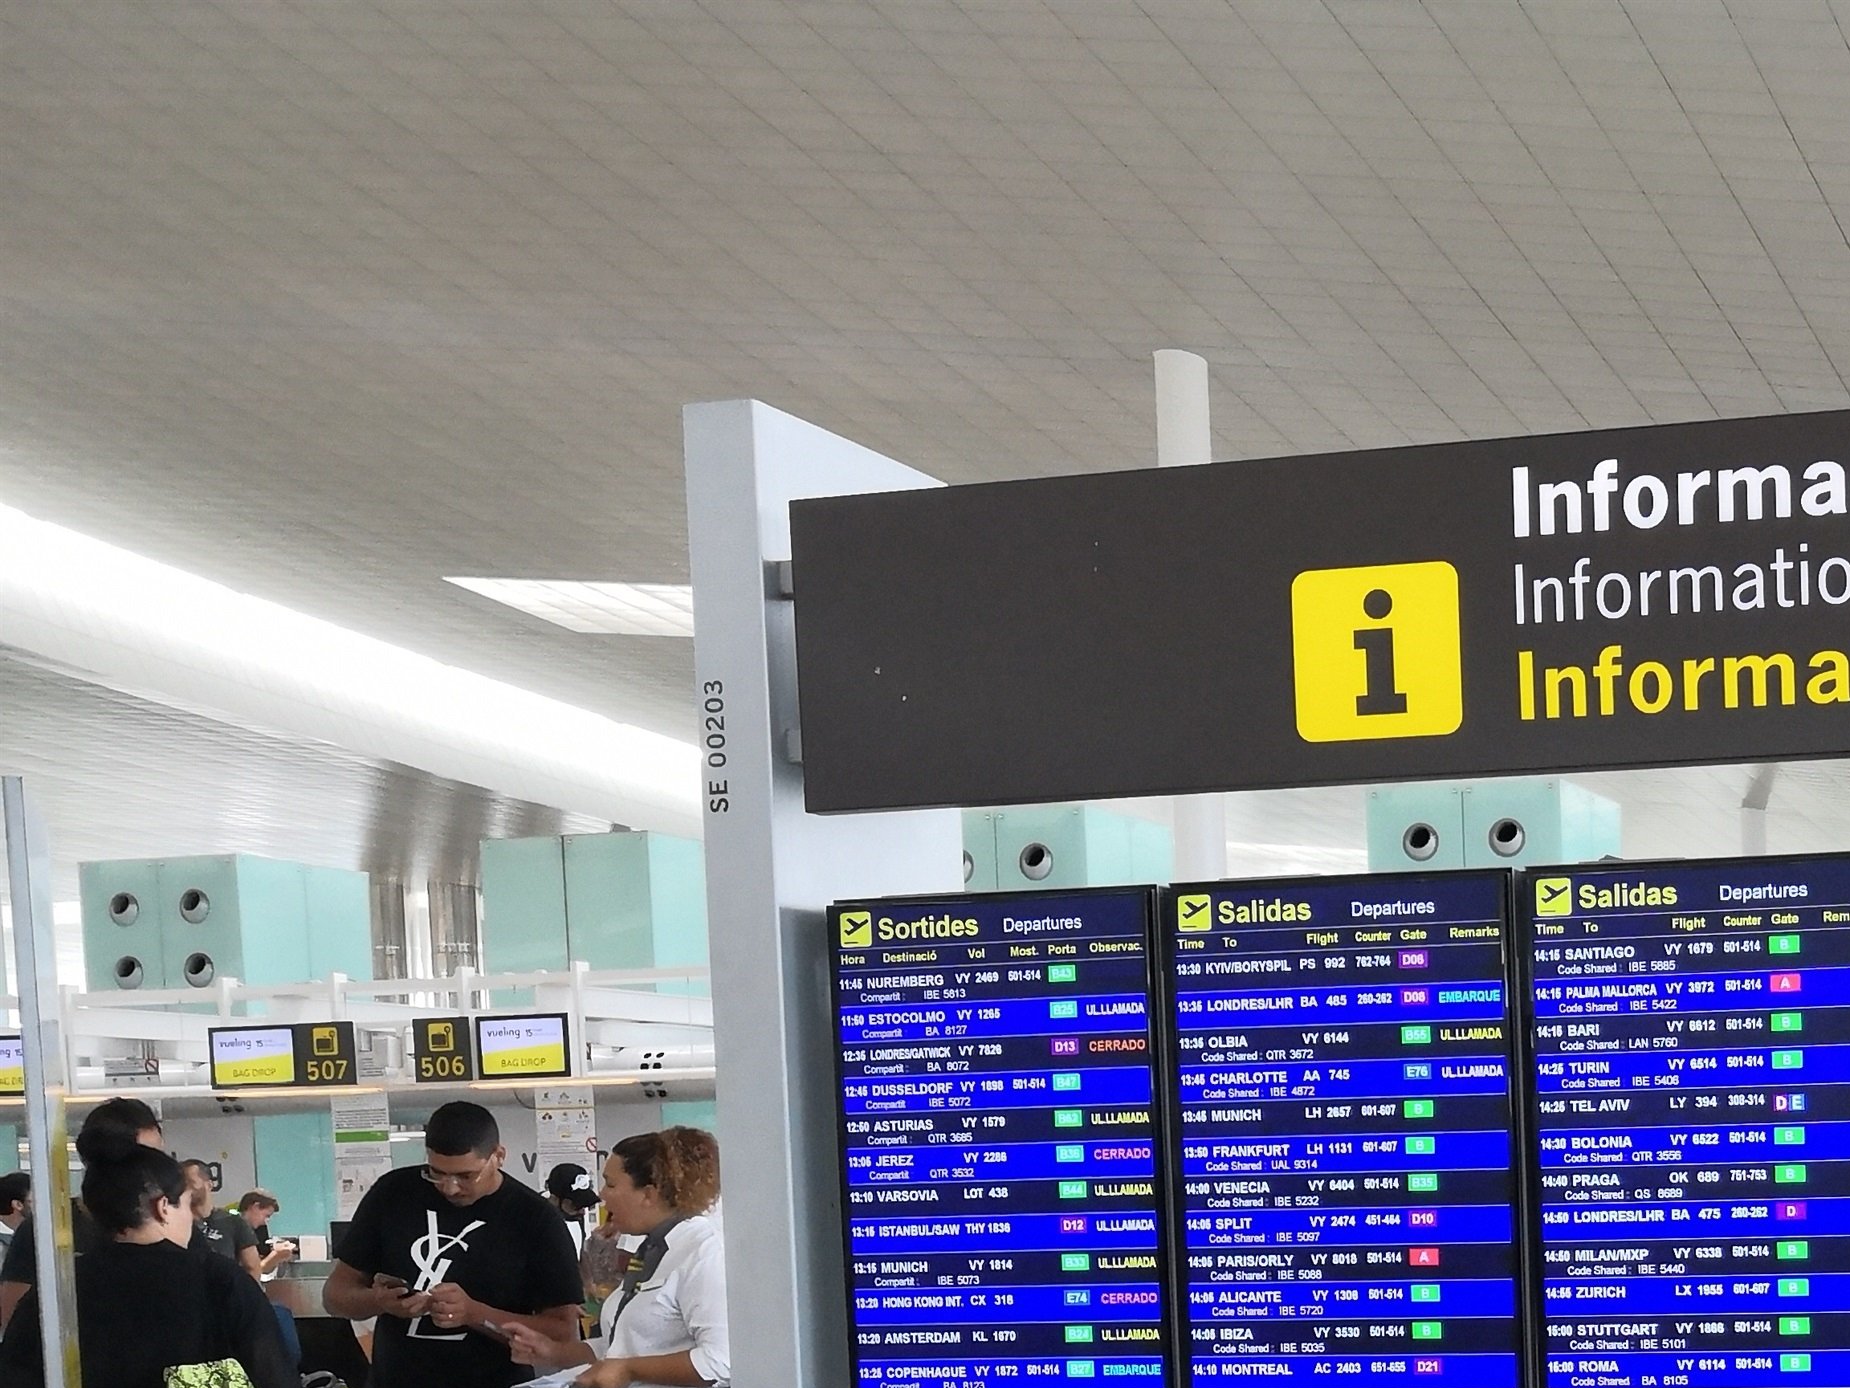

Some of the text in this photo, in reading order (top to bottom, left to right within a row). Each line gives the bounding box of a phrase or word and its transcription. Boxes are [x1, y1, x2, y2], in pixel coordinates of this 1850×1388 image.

[703, 680, 729, 813] SE 00203
[1579, 883, 1808, 908] Salidas Departures
[1218, 900, 1435, 923] Salidas Departures
[1771, 913, 1799, 924] Gate
[878, 915, 1082, 940] Sortides Departures
[1307, 926, 1499, 945] Flight Remarks
[882, 944, 1076, 963] Destinació Porta
[1565, 946, 1635, 959] SANTIAGO
[867, 974, 944, 989] NUREMBERG
[869, 1012, 945, 1025] ESTOCOLMO
[1089, 1040, 1145, 1052] CERRADO
[420, 1055, 465, 1077] 506
[500, 1058, 519, 1068] BAG
[1569, 1061, 1610, 1074] TURIN
[306, 1059, 348, 1081] 507
[1210, 1071, 1287, 1084] CHARLOTTE
[874, 1119, 933, 1132] ASTURIAS
[1572, 1136, 1632, 1148] BOLONIA
[1213, 1144, 1289, 1157] FRANKFURT
[1215, 1217, 1252, 1229] SPLIT
[1576, 1286, 1626, 1299] ZURICH
[1577, 1324, 1659, 1336] STUTTGART
[886, 1367, 966, 1378] COPENHAGUE
[1222, 1363, 1293, 1376] MONTREAL
[1579, 1361, 1619, 1372] ROMA
